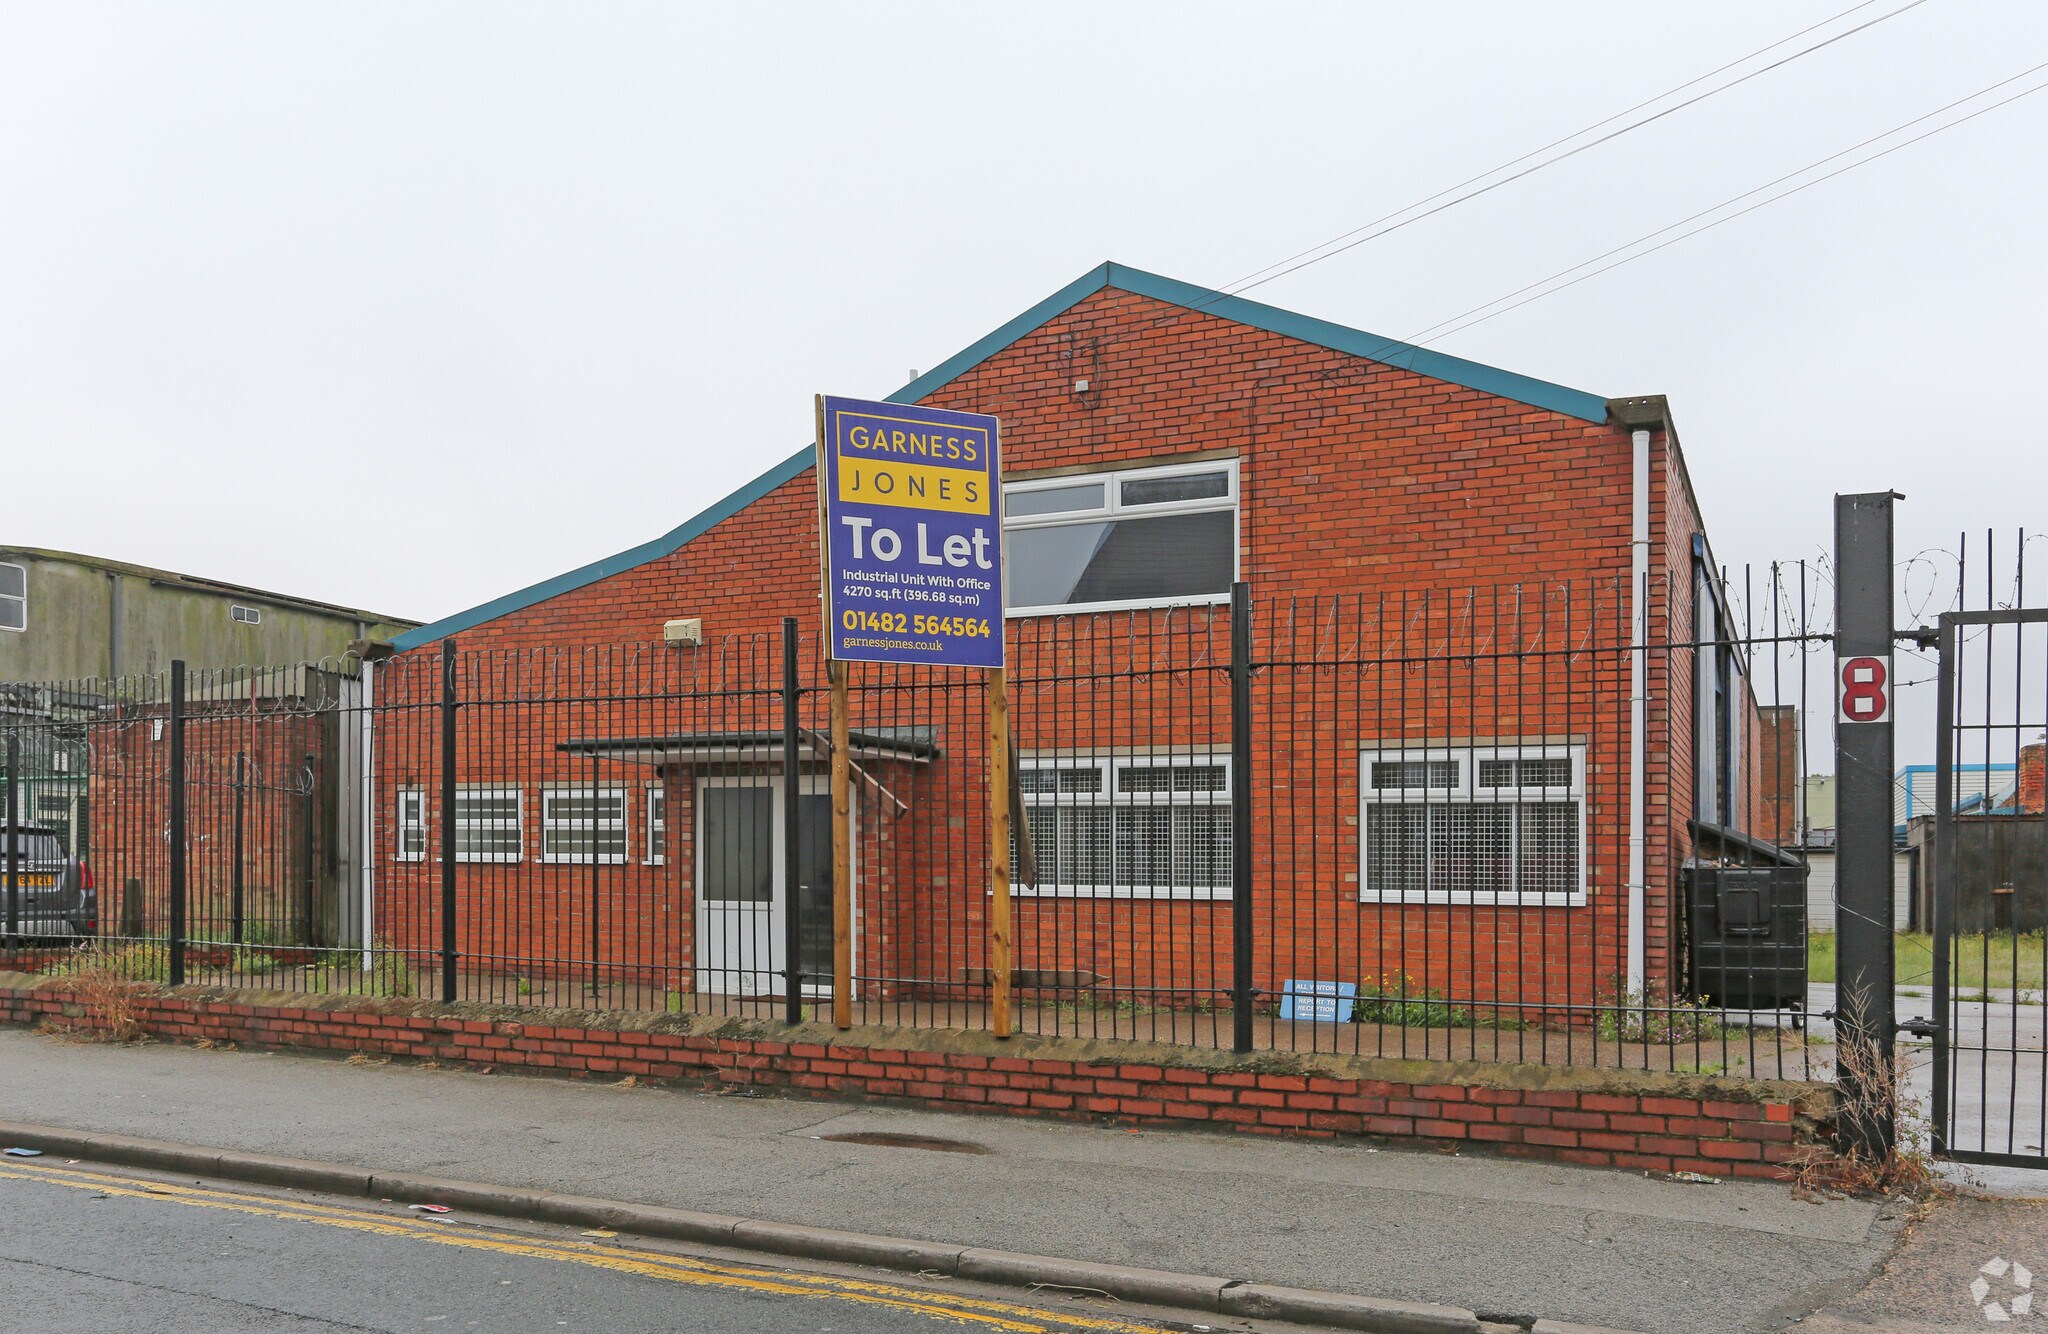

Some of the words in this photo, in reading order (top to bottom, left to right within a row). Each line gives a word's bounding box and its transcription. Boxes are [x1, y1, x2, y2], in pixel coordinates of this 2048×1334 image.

[850, 426, 977, 461] GARNESS
[852, 470, 978, 502] JONES
[841, 515, 902, 562] To
[917, 522, 993, 570] Let
[843, 569, 898, 584] Industrial
[901, 573, 925, 585] Unit
[927, 575, 954, 588] With
[957, 577, 991, 590] Office
[843, 585, 872, 597] 4270
[875, 588, 901, 601] sq.ft
[904, 588, 946, 603] (396.68
[949, 593, 980, 606] sq.m)
[842, 609, 908, 633] 01482
[913, 614, 990, 638] 564564
[843, 636, 943, 651] garnessjones.co.uk
[1842, 657, 1886, 722] 8
